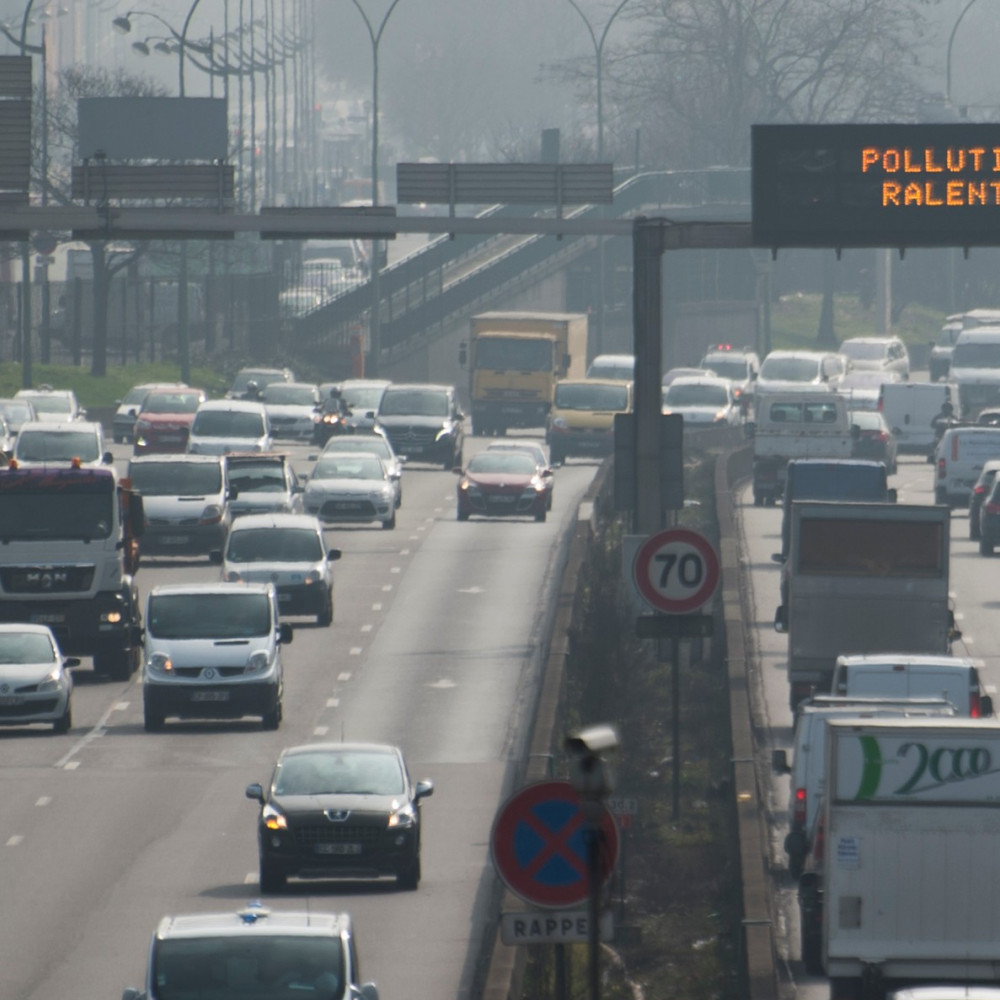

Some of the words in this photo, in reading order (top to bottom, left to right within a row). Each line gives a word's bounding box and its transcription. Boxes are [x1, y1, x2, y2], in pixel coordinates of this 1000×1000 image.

[27, 572, 67, 582] MAN
[655, 553, 703, 589] 70
[514, 918, 588, 937] RAPPE
